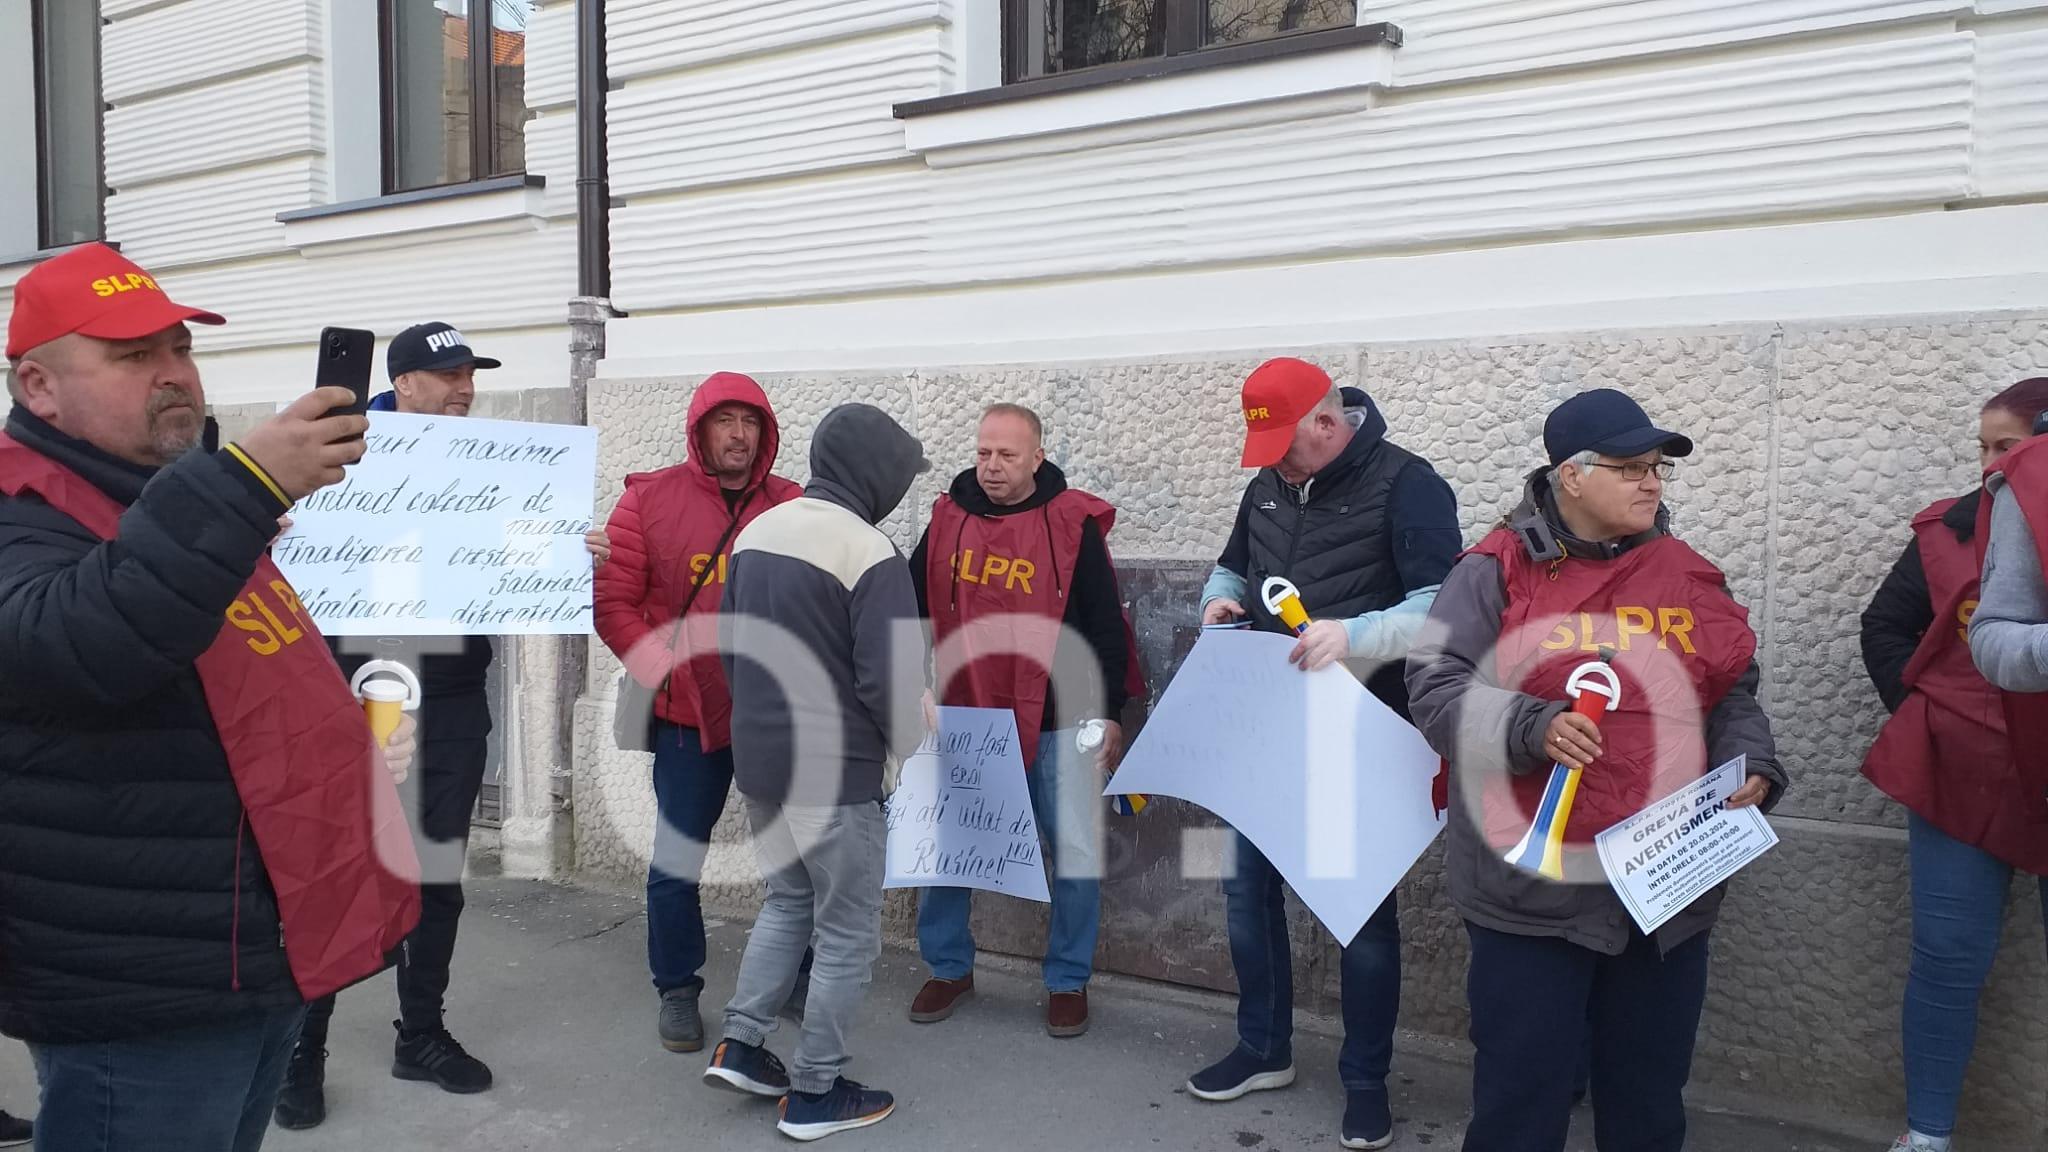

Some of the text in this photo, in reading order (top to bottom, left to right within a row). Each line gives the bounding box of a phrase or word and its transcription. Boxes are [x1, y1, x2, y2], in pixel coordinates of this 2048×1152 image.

[91, 273, 160, 297] SLPR
[1245, 407, 1271, 420] LPR
[446, 437, 570, 466] maxime
[288, 475, 554, 515] ontract colectiv de
[1633, 788, 1717, 844] GREVĂ DE
[1656, 853, 1678, 871] DATA
[1677, 845, 1689, 857] DE
[1688, 819, 1728, 850] 20.03.2024
[1671, 853, 1698, 874] ORELE:
[1697, 825, 1741, 856] 08:00-10:00
